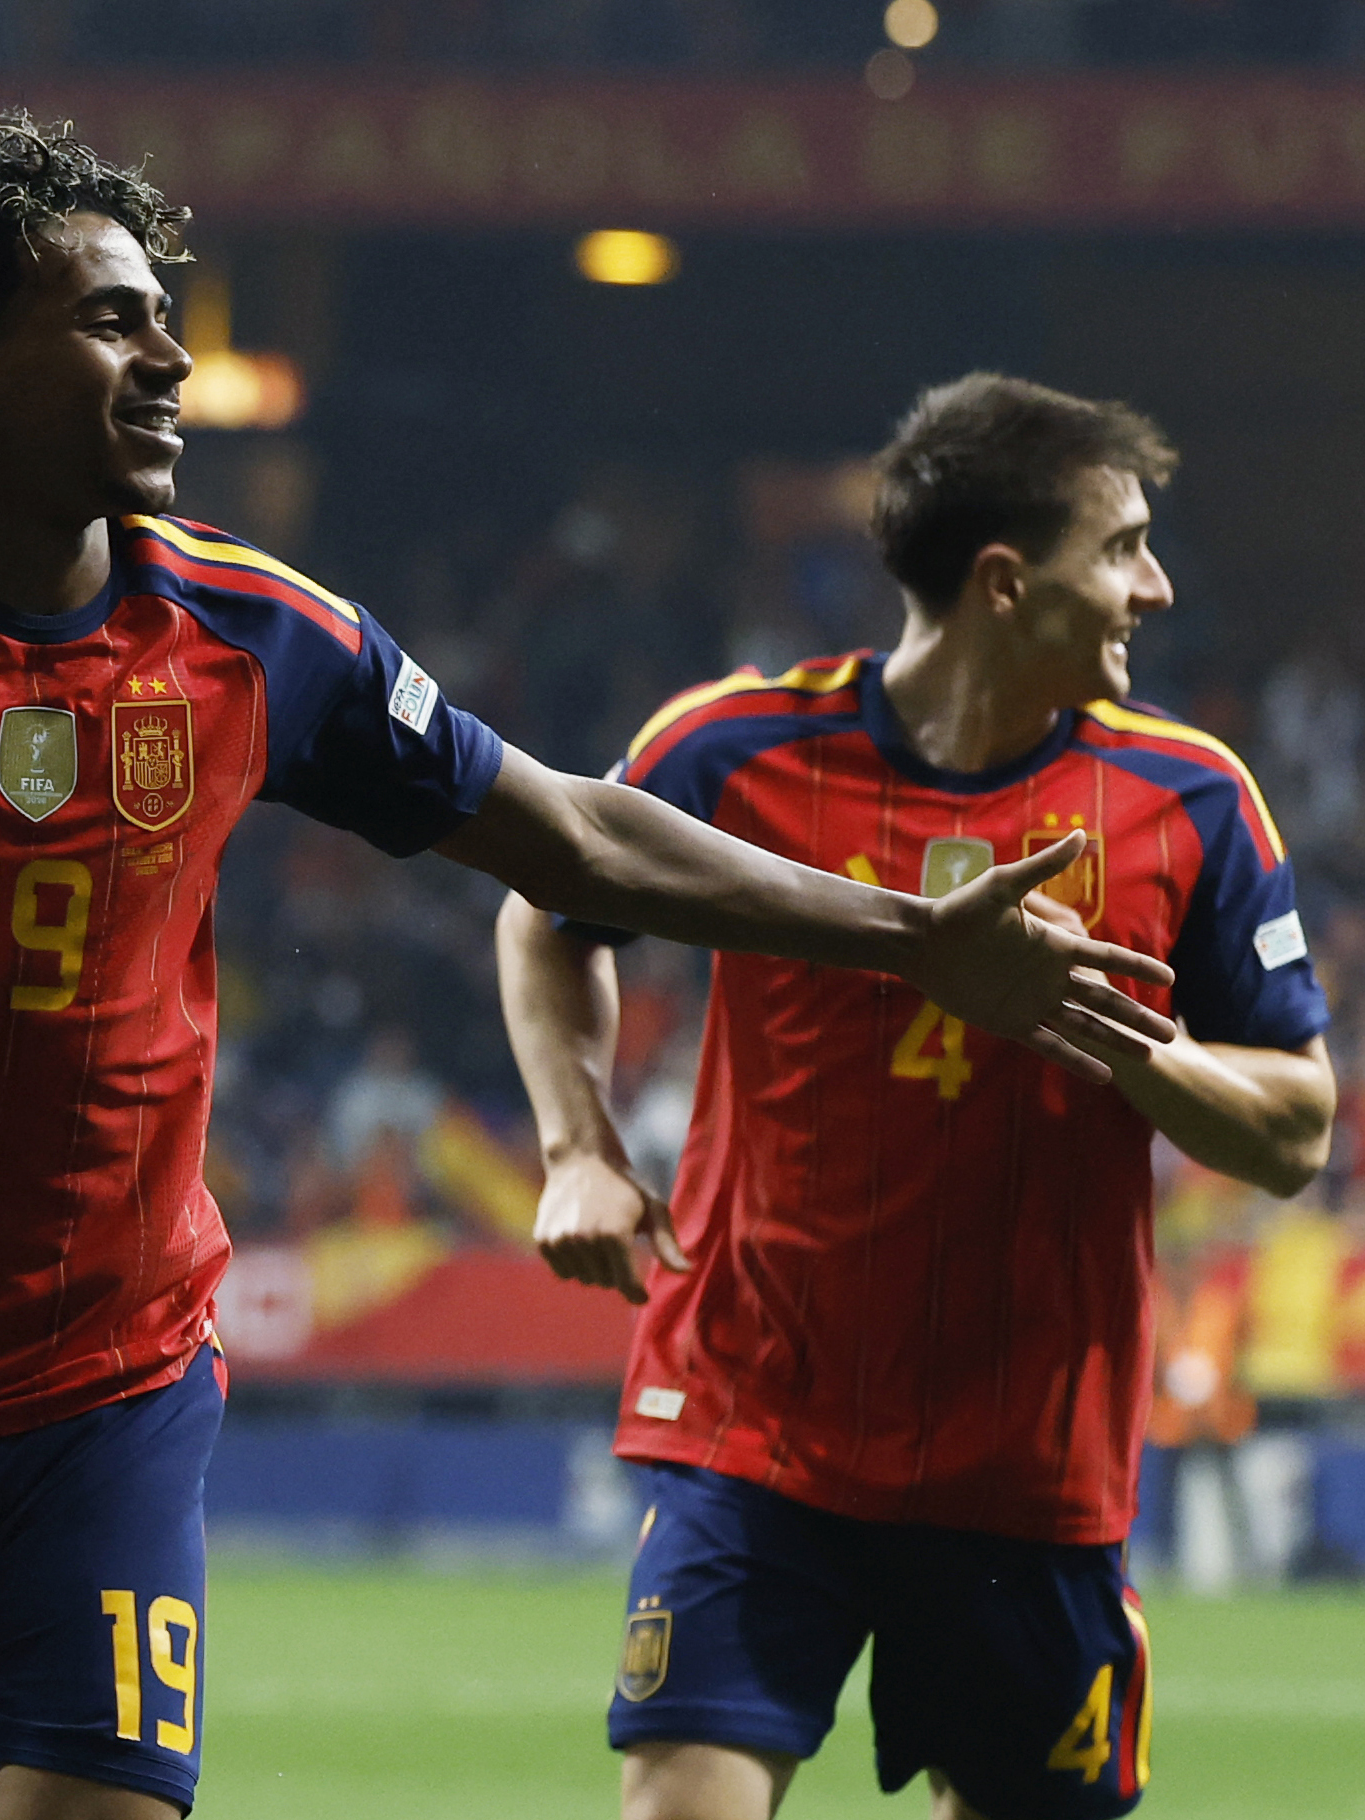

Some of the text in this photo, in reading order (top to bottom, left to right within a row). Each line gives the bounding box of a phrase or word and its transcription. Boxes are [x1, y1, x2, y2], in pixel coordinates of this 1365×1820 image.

[20, 777, 55, 792] FIFA
[891, 999, 972, 1099] 4
[101, 1589, 199, 1756] 19
[1047, 1663, 1113, 1785] 4
